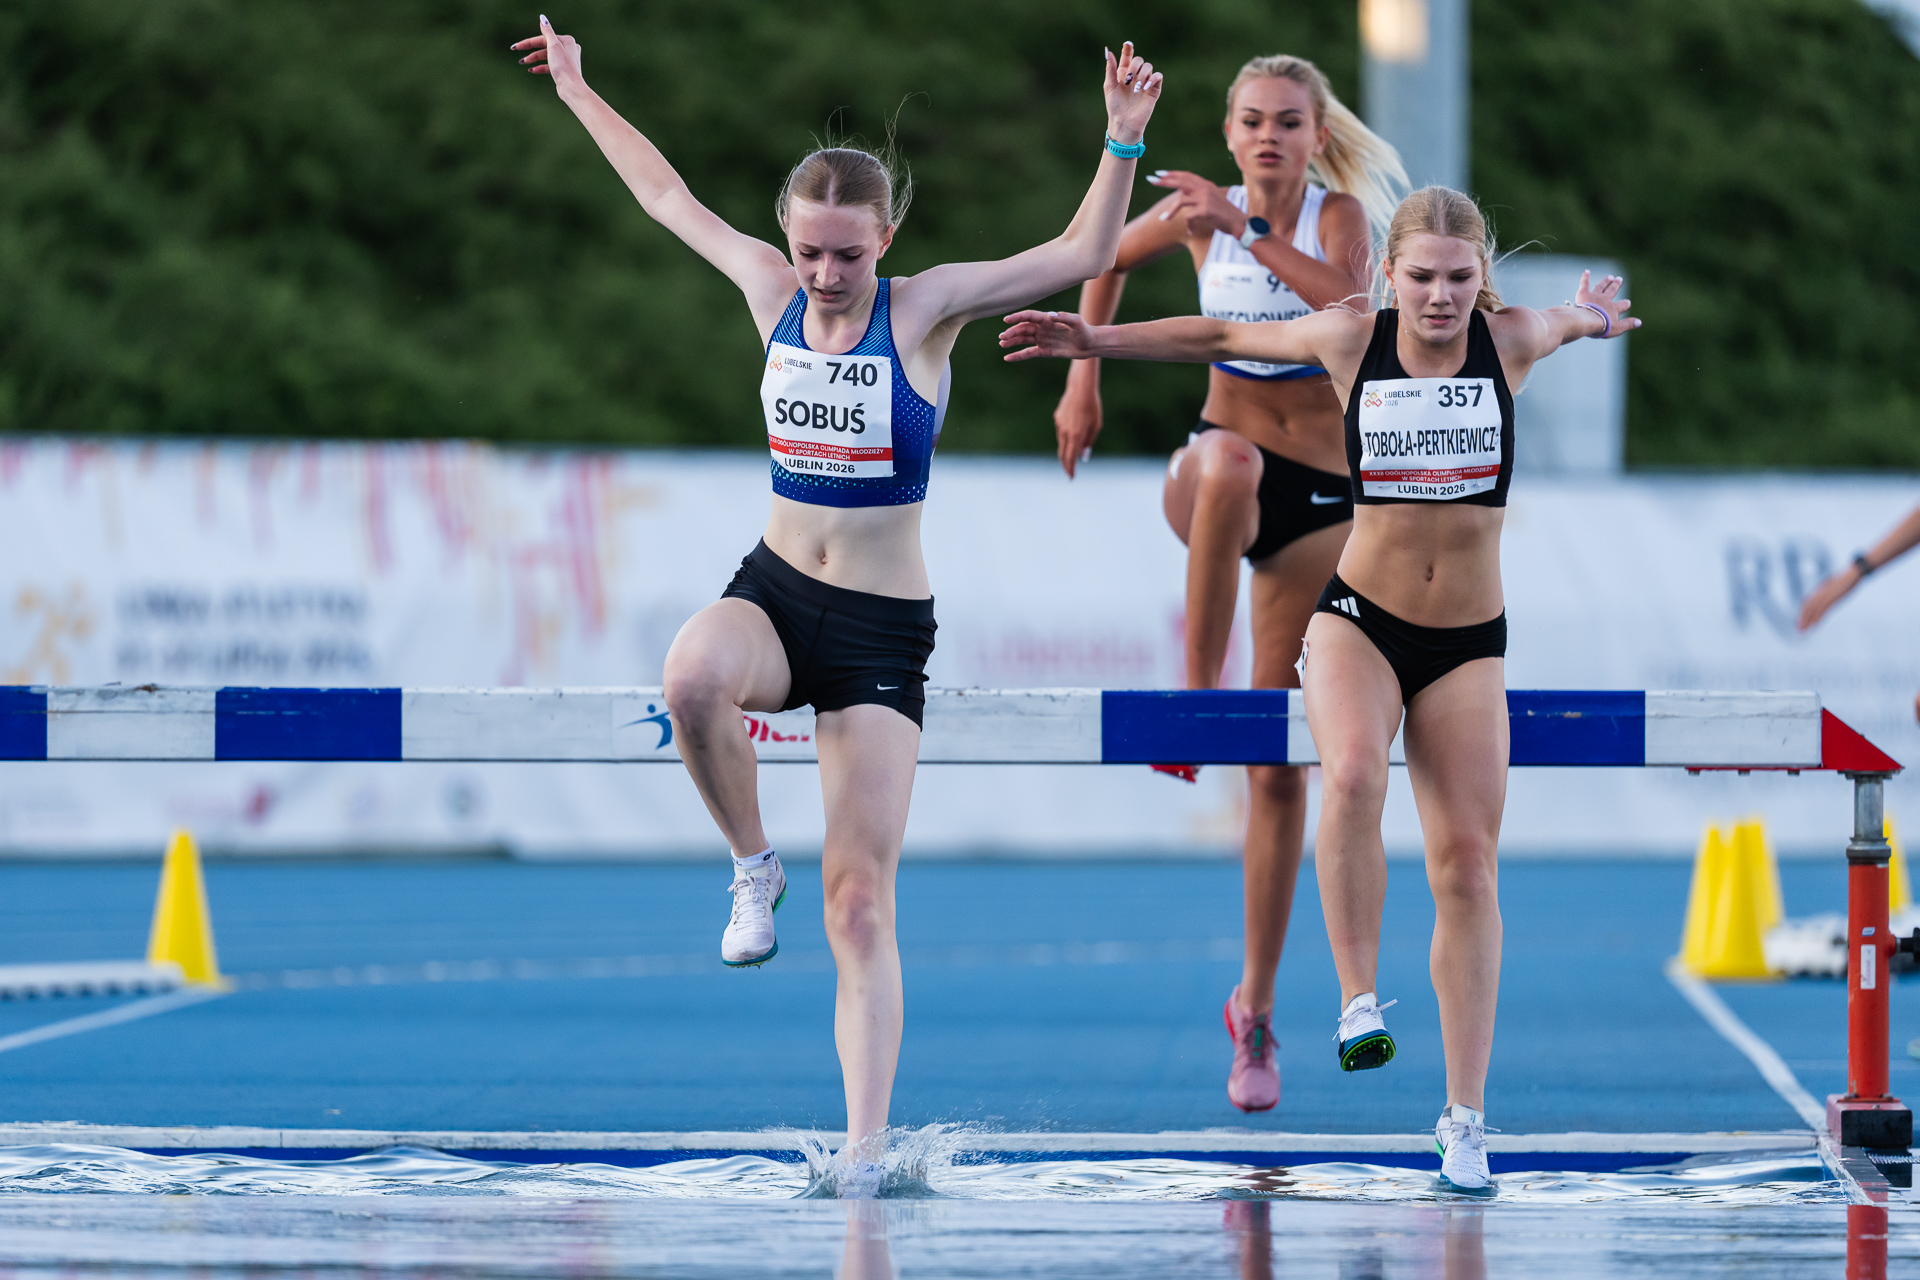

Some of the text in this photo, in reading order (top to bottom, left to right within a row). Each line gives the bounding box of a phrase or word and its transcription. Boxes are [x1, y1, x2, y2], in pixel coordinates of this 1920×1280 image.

[784, 357, 813, 371] LUBELSKIE
[826, 361, 878, 387] 740
[1384, 390, 1422, 398] LUBELSKIE
[1437, 385, 1483, 408] 357
[775, 397, 866, 435] SOBUŚ
[1364, 426, 1497, 458] TOBOŁA-PERTKIEWICZ
[795, 449, 827, 458] SPORTACH
[820, 445, 850, 454] OLIMPIADA
[784, 457, 855, 473] LUBLIN 2026
[1440, 474, 1462, 483] LETNICH
[1397, 483, 1466, 495] LUBLIN 2026
